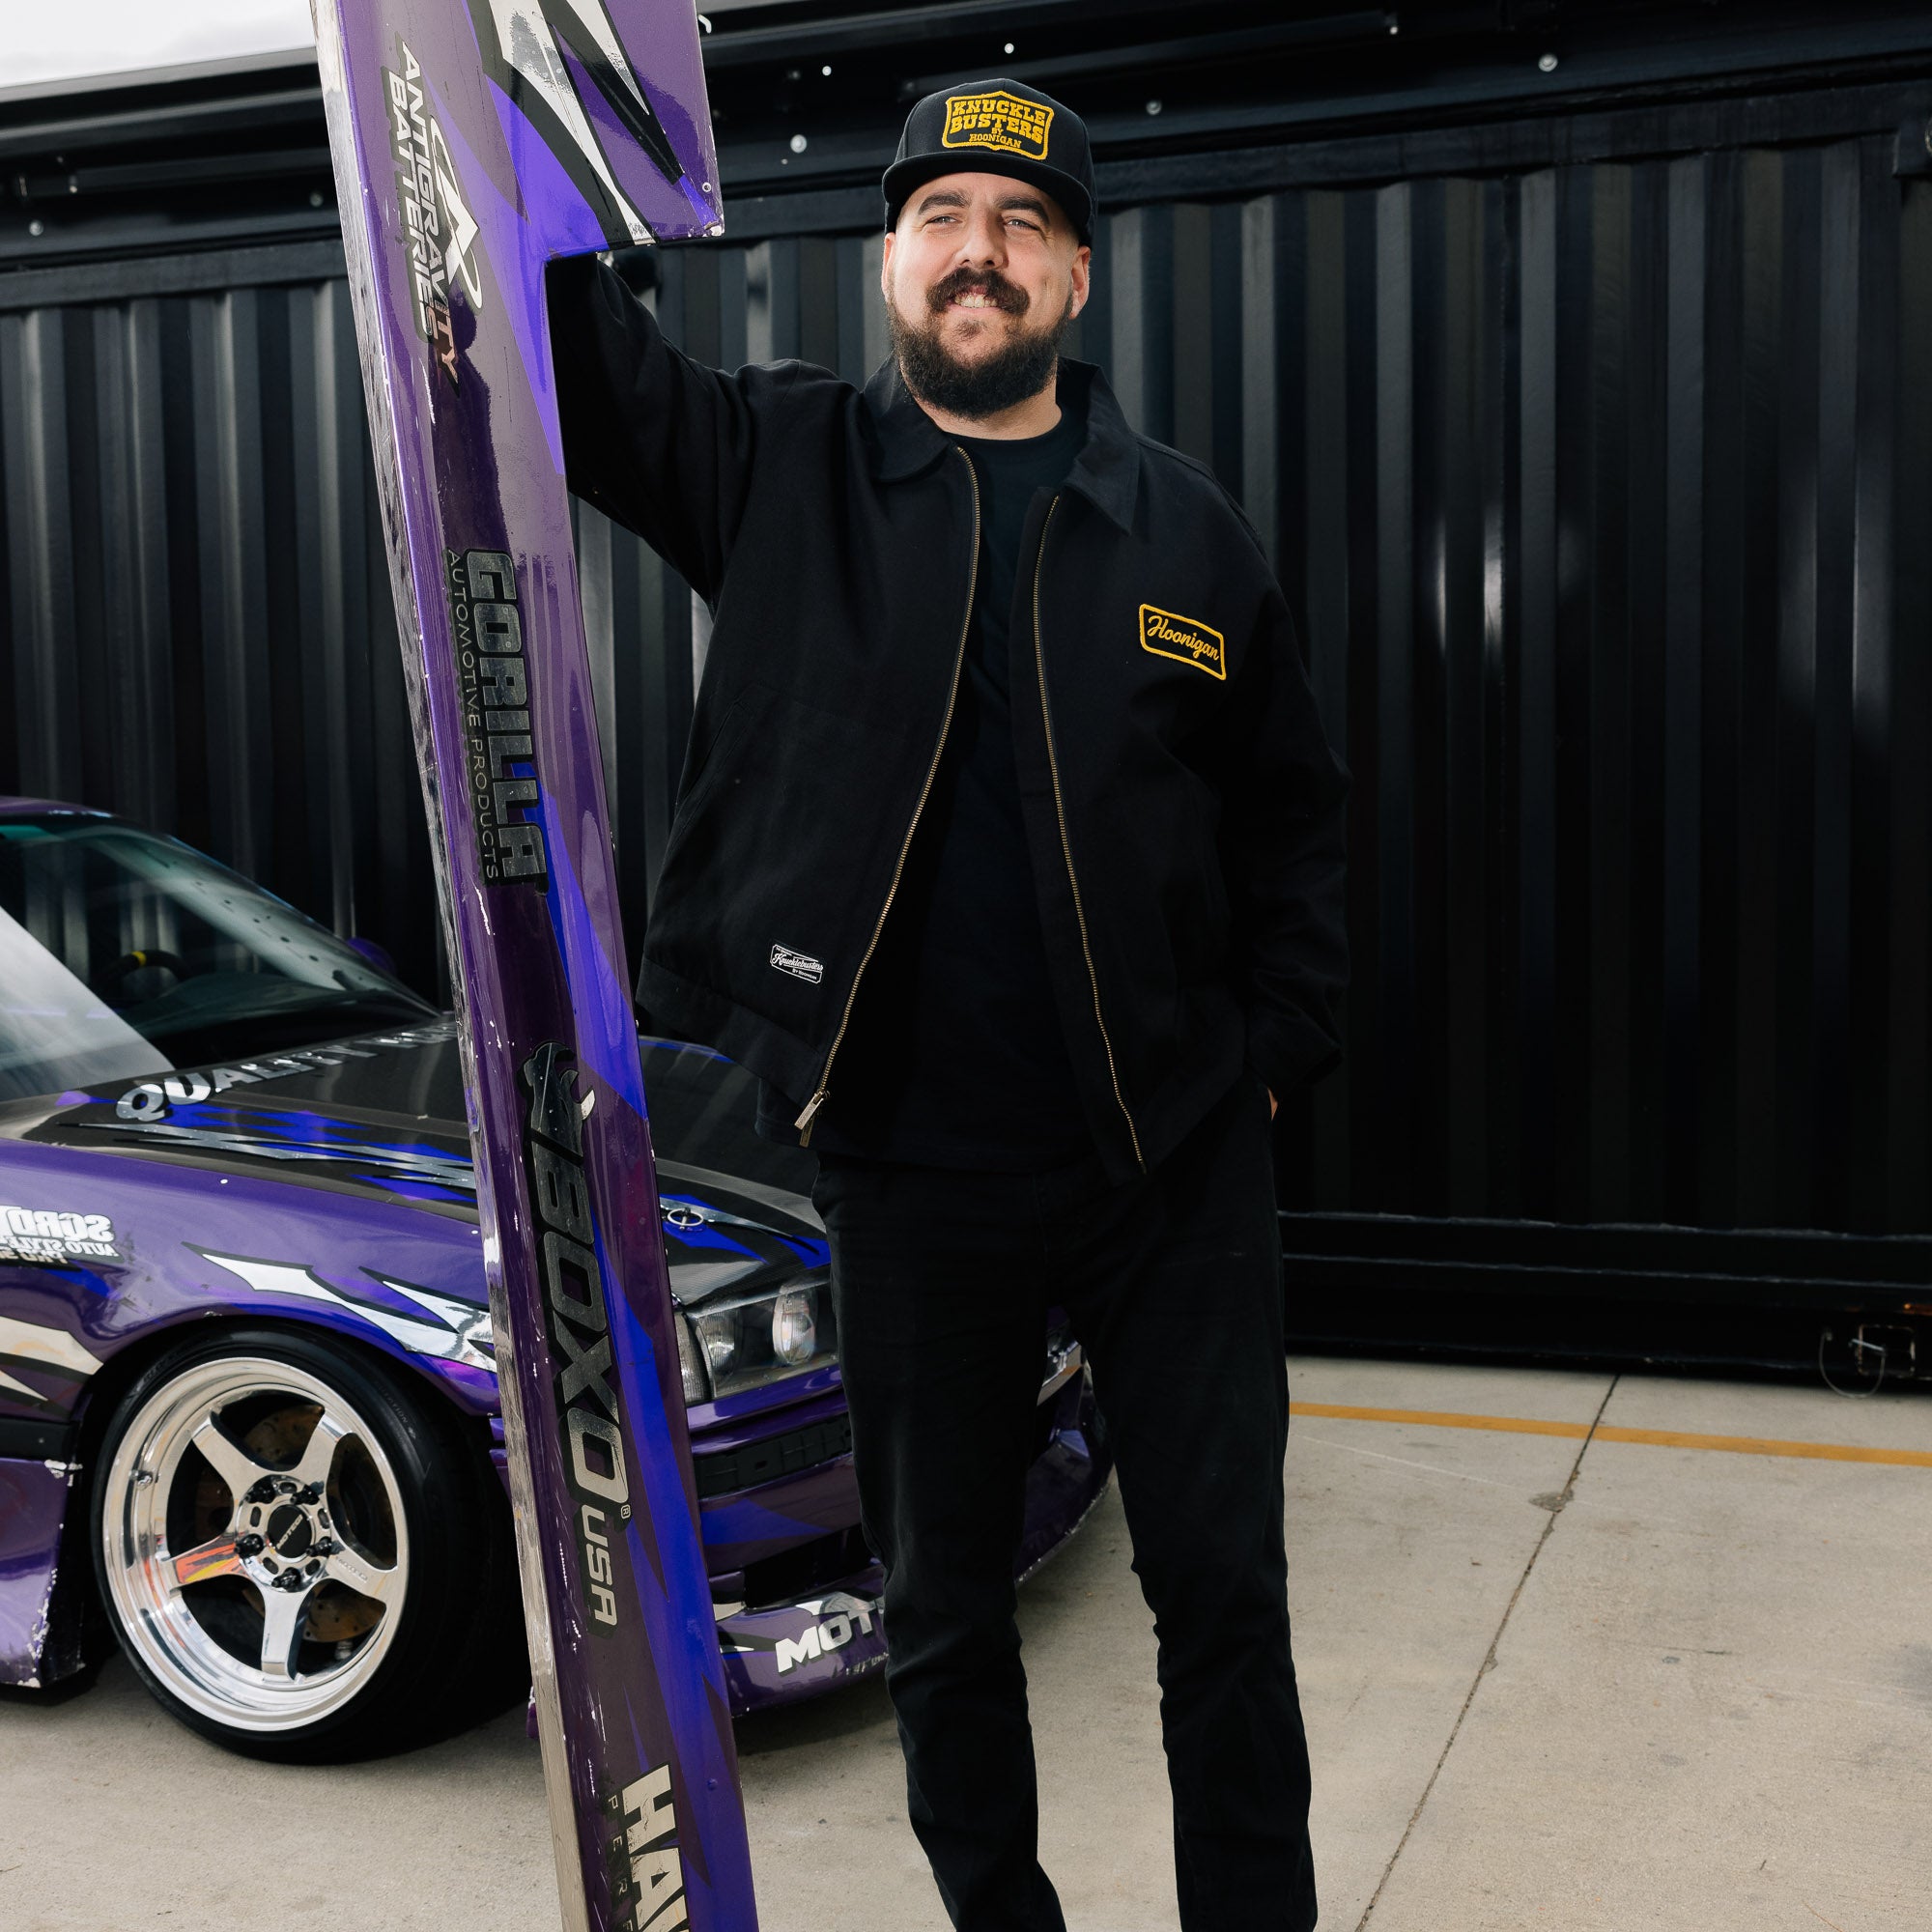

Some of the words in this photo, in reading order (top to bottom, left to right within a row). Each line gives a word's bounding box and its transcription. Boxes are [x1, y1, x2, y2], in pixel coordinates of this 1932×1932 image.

[950, 113, 1044, 144] BUSTERS
[952, 99, 1045, 127] KNUCKLE
[969, 133, 1022, 148] HOONIGAN
[991, 127, 1003, 135] BY
[389, 71, 439, 340] BATTERIES
[403, 41, 459, 384] ANTIGRAVITY
[1147, 615, 1219, 661] Hoonigan
[447, 549, 480, 727] AUTOMOTIVE
[471, 739, 498, 879] PRODUCTS
[467, 552, 548, 877] GORILLA
[582, 1504, 617, 1626] USA
